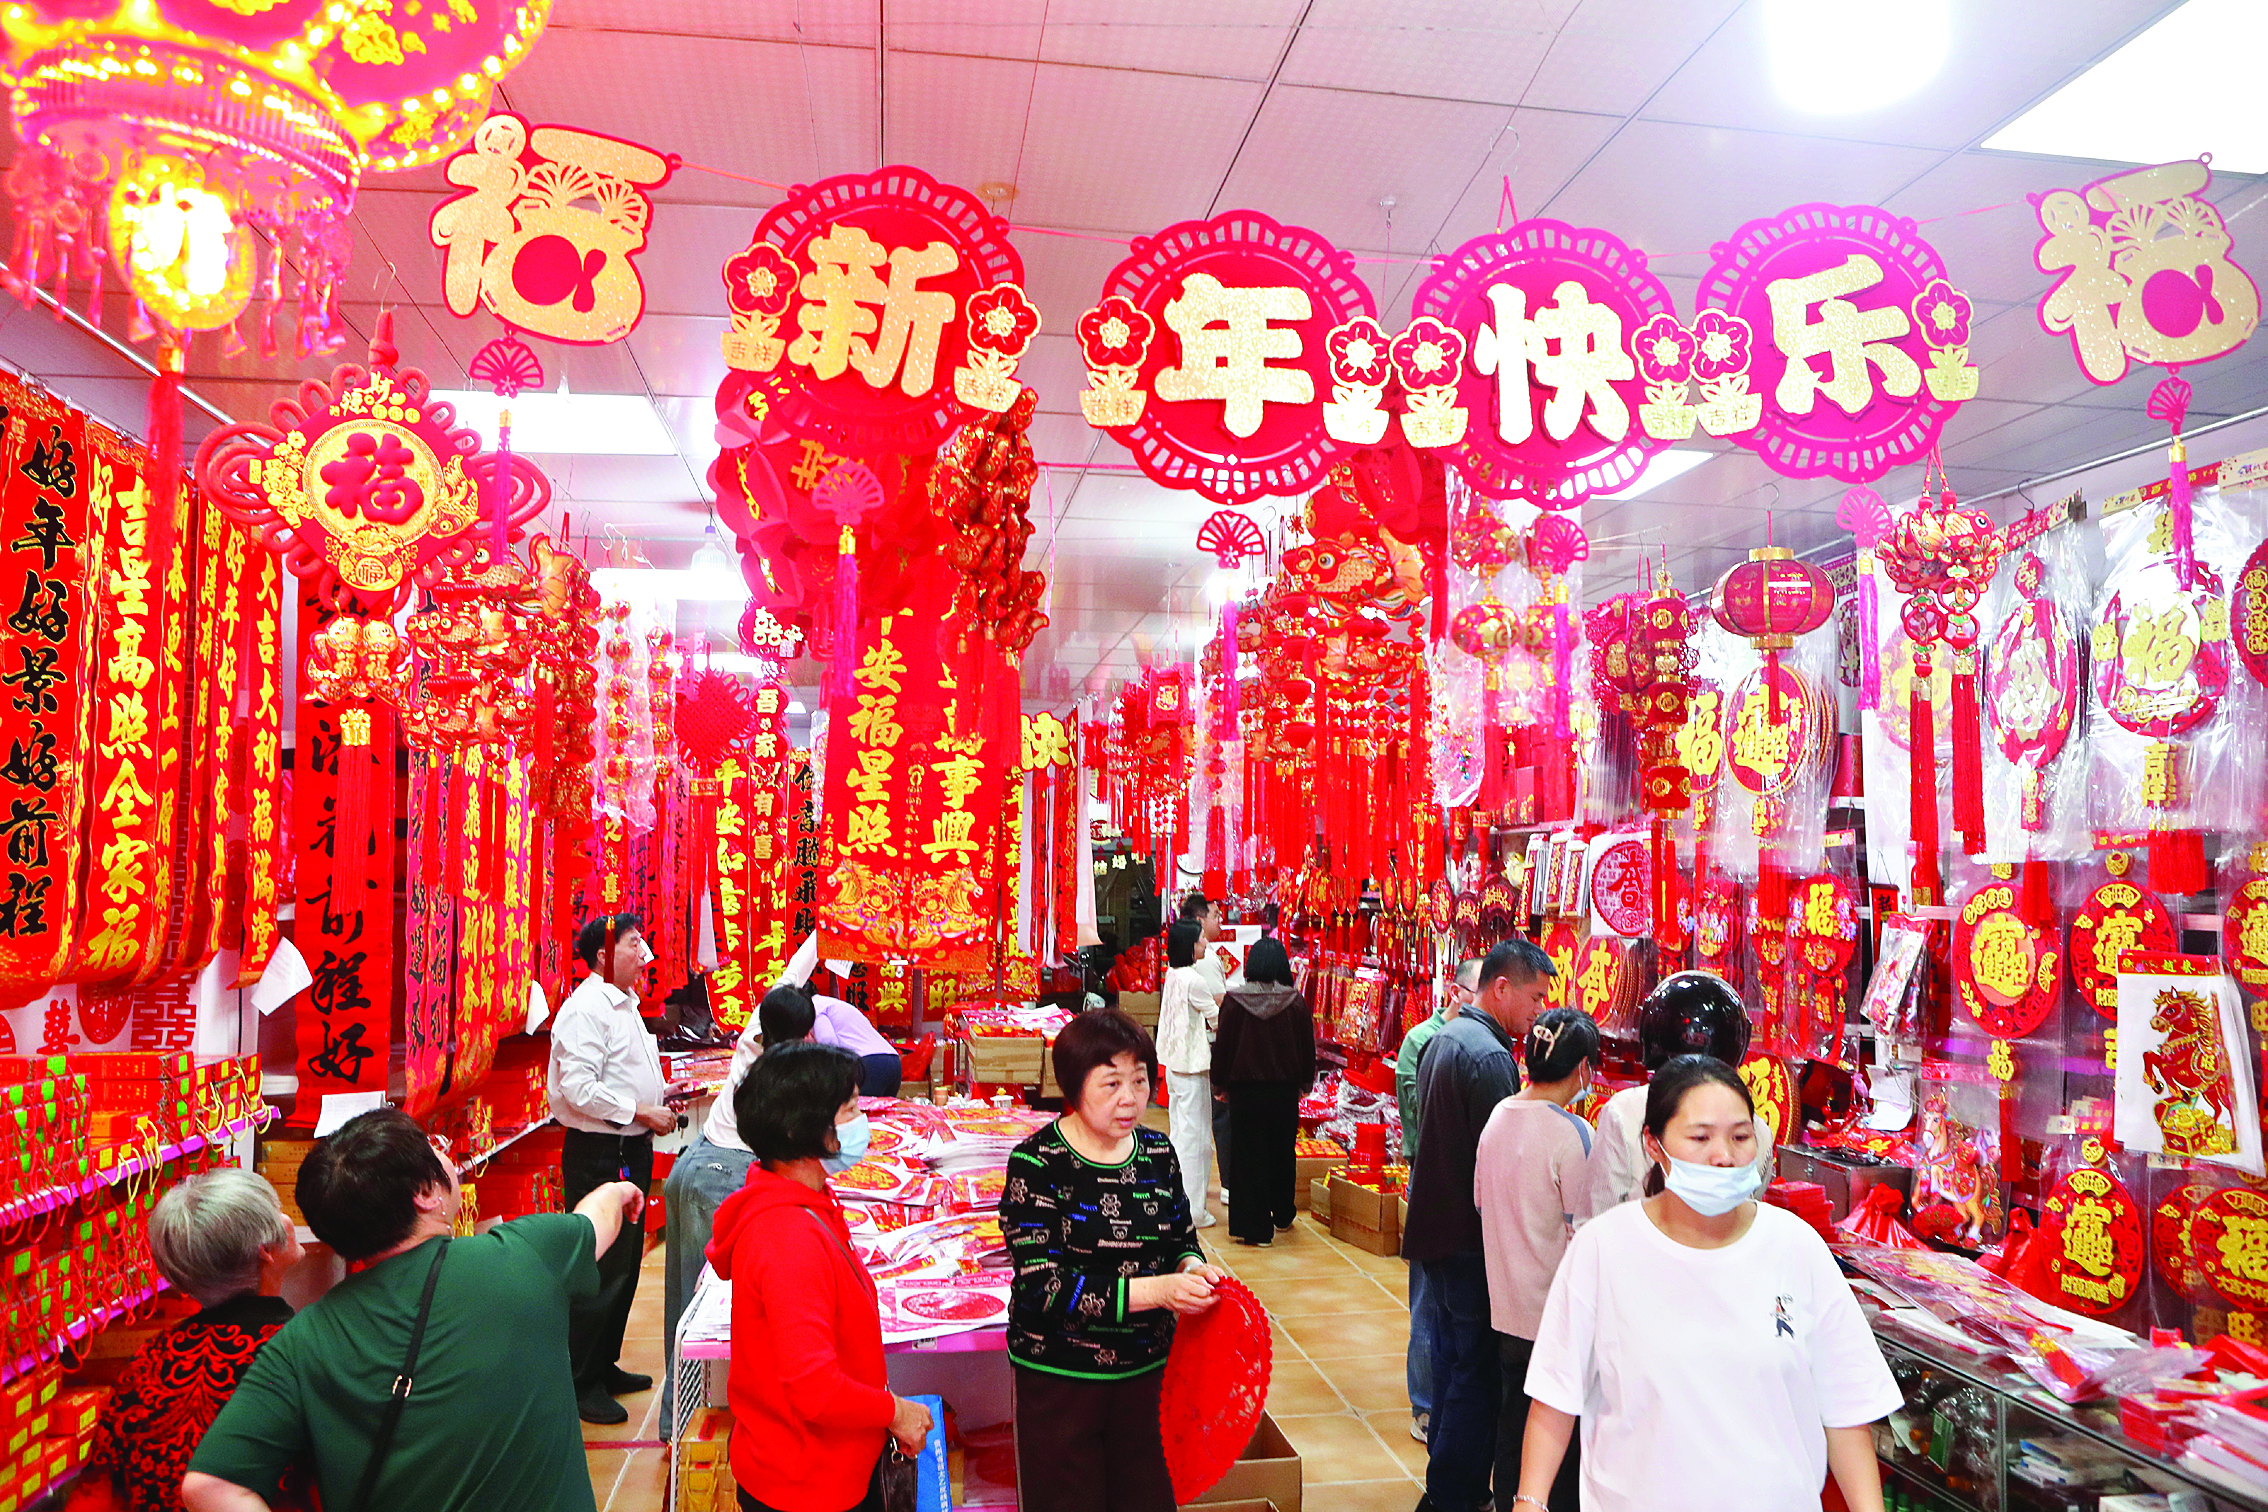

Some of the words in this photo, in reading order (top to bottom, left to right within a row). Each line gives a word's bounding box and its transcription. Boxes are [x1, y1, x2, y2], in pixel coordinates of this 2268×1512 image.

[432, 115, 668, 342] 福
[2038, 163, 2260, 382] 福
[320, 433, 424, 525] 福
[0, 425, 76, 938] 好年好景好前程
[2121, 592, 2197, 685] 福
[88, 475, 154, 970] 吉星高照全家福
[1021, 712, 1070, 770] 快
[1675, 691, 1721, 776] 福
[1806, 884, 1834, 936] 福
[1987, 1039, 2015, 1081] 福
[2217, 1215, 2268, 1282] 福
